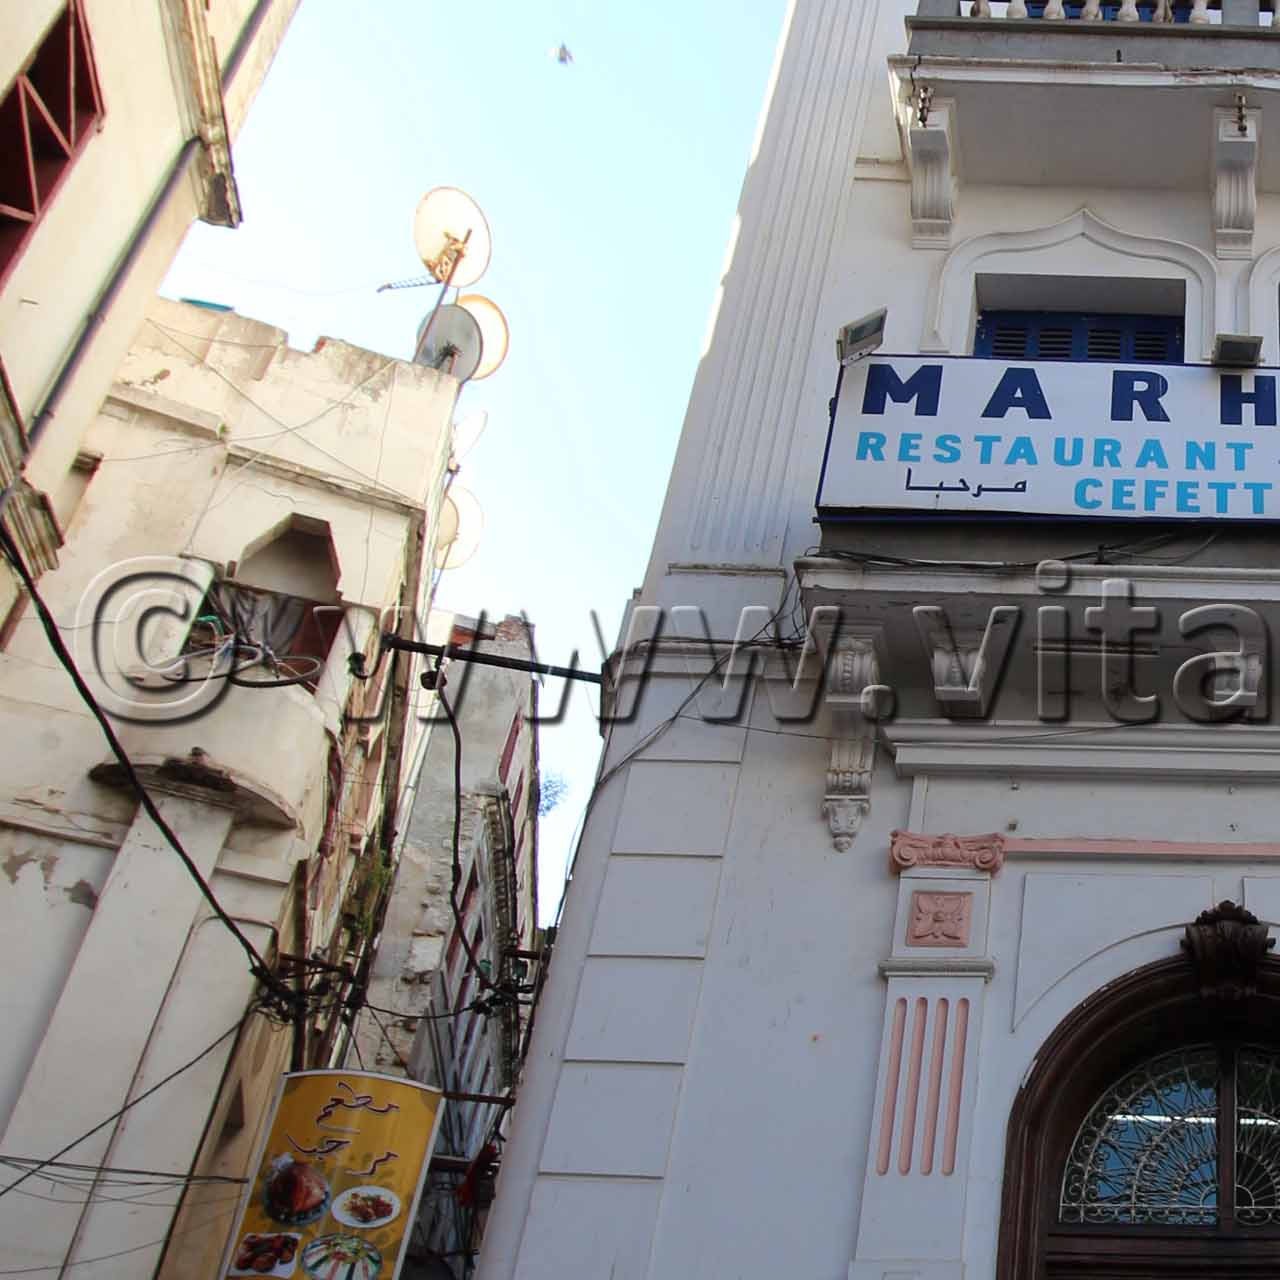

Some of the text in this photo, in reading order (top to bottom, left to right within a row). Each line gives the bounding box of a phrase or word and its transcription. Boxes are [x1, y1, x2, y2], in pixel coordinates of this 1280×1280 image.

[856, 431, 1254, 471] RESTAURANT
[905, 467, 1028, 498] مرحبا
[315, 1079, 401, 1135] مطعم
